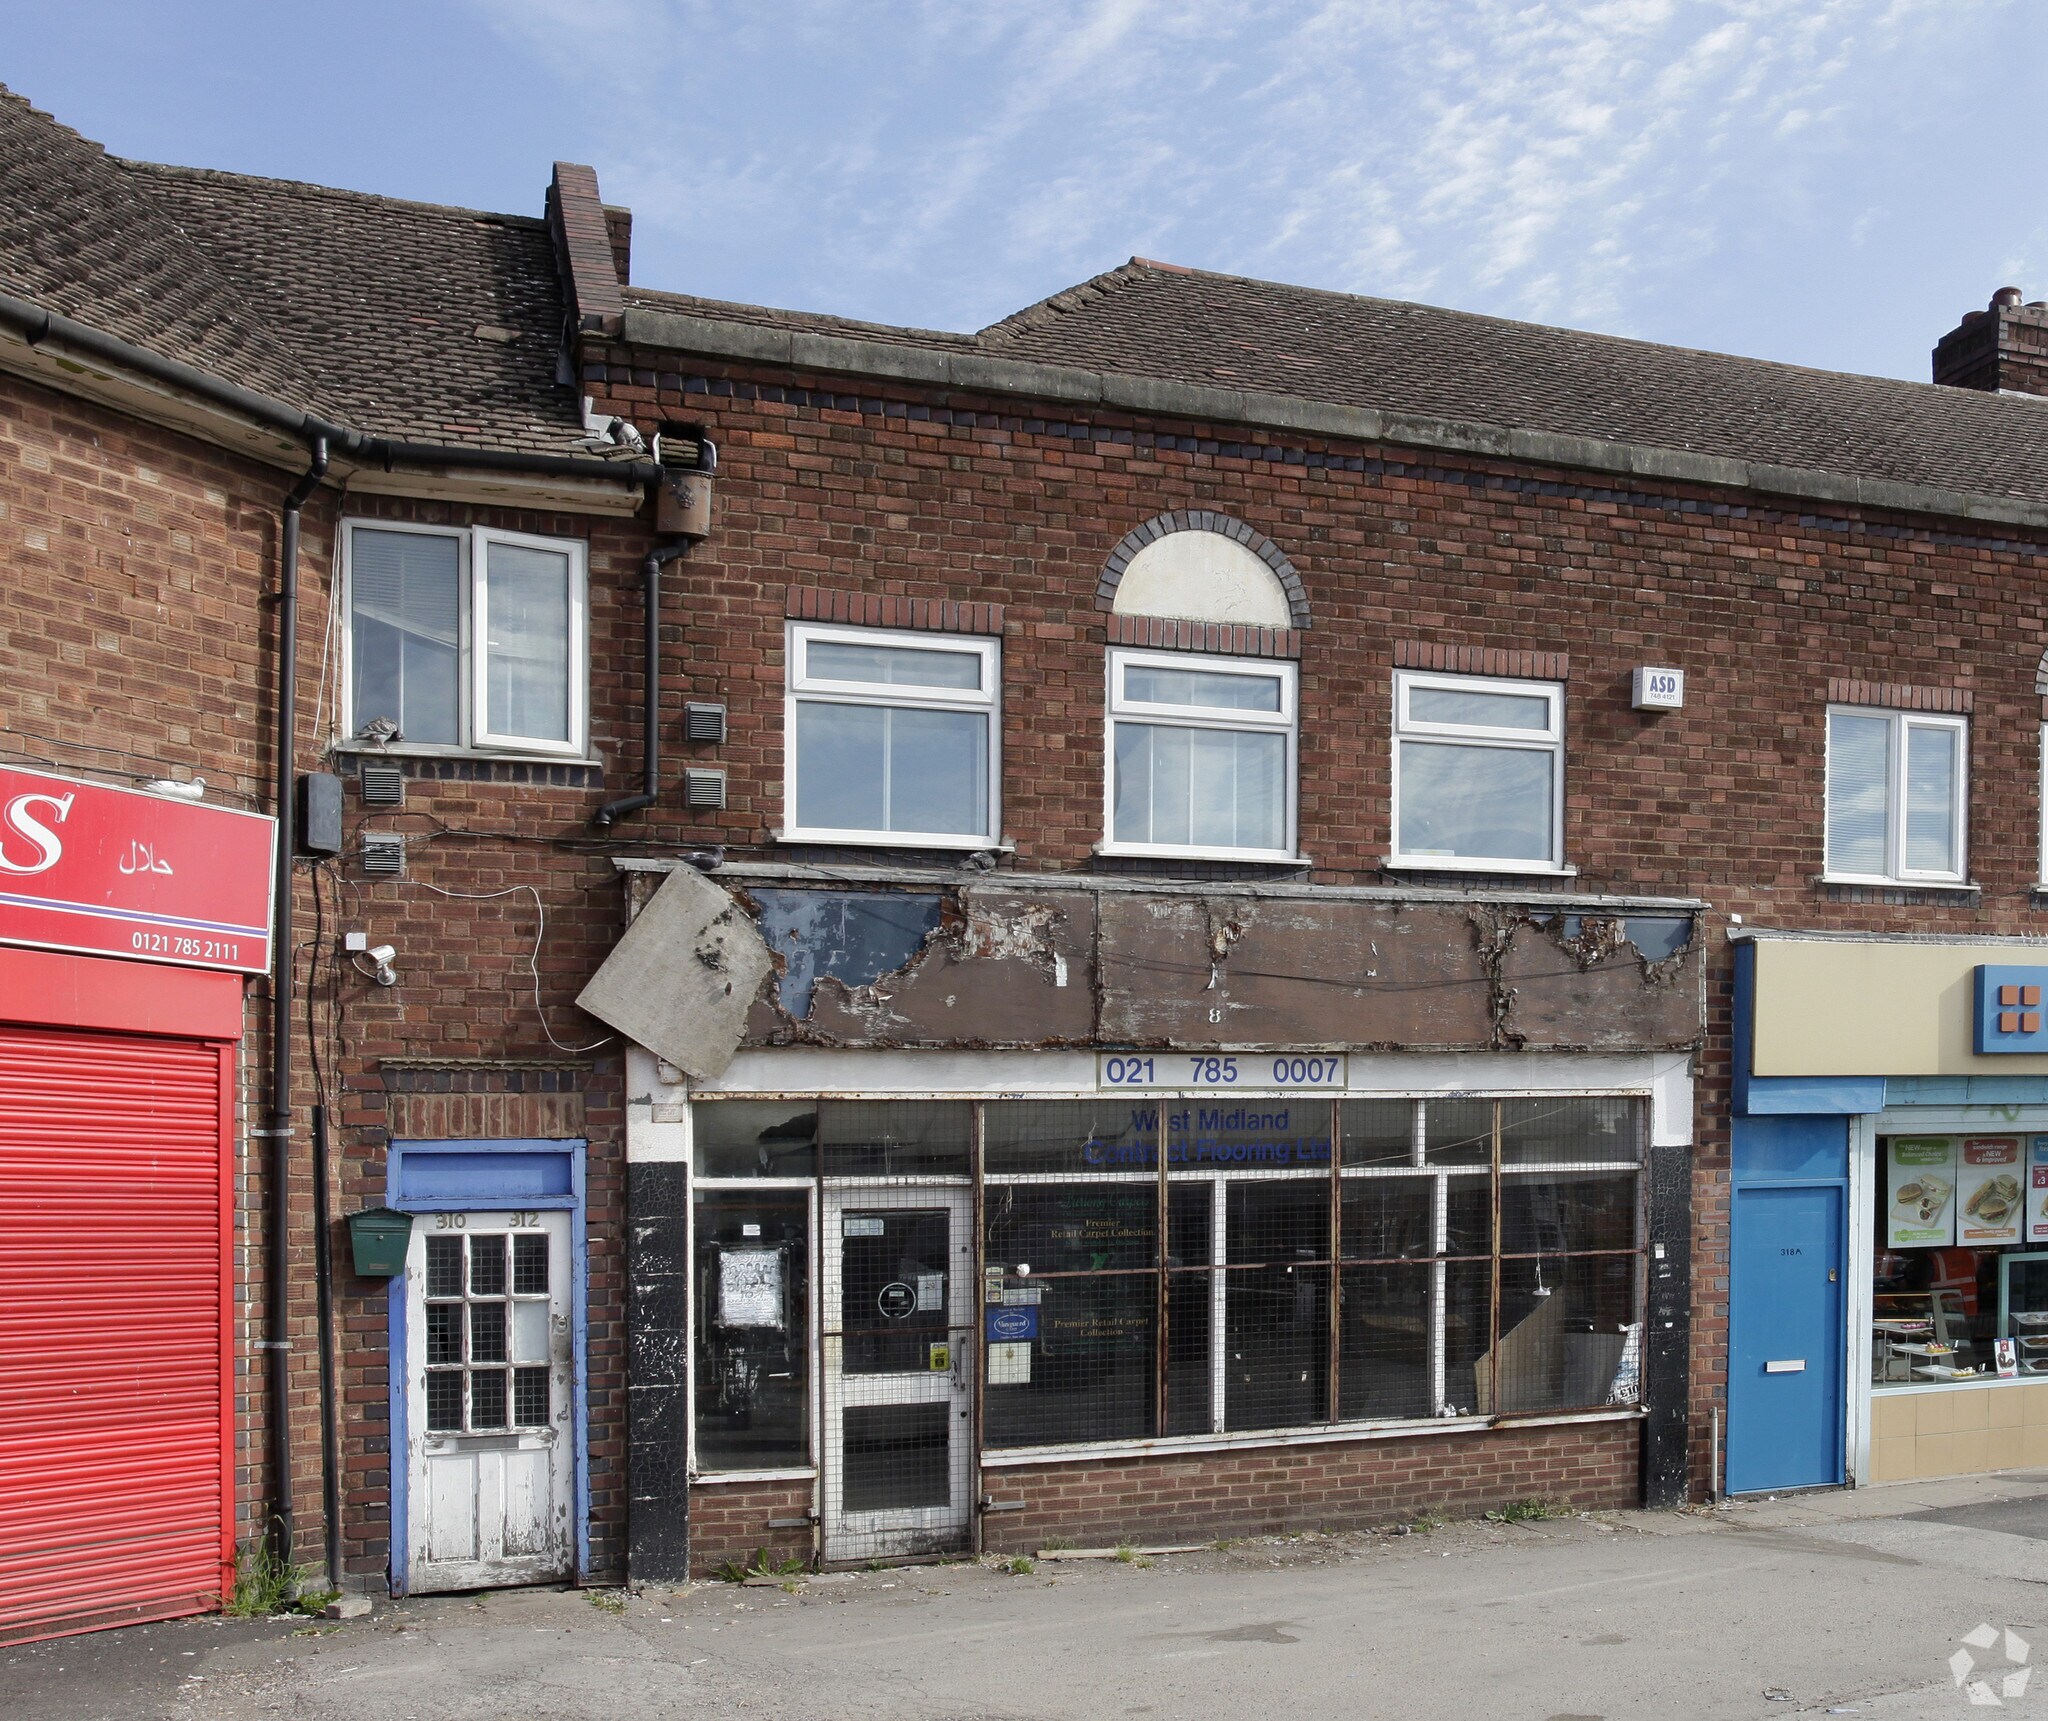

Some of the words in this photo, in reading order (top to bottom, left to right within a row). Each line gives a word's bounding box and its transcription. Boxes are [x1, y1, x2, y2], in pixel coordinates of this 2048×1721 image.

[1649, 675, 1676, 693] ASD
[119, 838, 174, 875] حلال
[132, 931, 168, 952] 0121
[174, 937, 201, 956] 785
[204, 941, 239, 961] 2111
[1106, 1057, 1154, 1083] 021
[1190, 1057, 1238, 1083] 785
[1273, 1057, 1339, 1083] 0007
[1199, 1108, 1289, 1131] Midland
[1196, 1138, 1290, 1165] Flooring
[1296, 1136, 1331, 1160] Ltd
[435, 1213, 467, 1229] 310
[509, 1212, 541, 1228] 312
[1085, 1219, 1120, 1228] Premier
[1051, 1229, 1077, 1238] Retail
[1079, 1229, 1109, 1239] Carpet
[1111, 1228, 1154, 1237] Collection
[1054, 1319, 1089, 1328] Premier
[1092, 1318, 1117, 1327] Retail
[1119, 1317, 1149, 1327] Carpet
[1080, 1328, 1124, 1337] Collection
